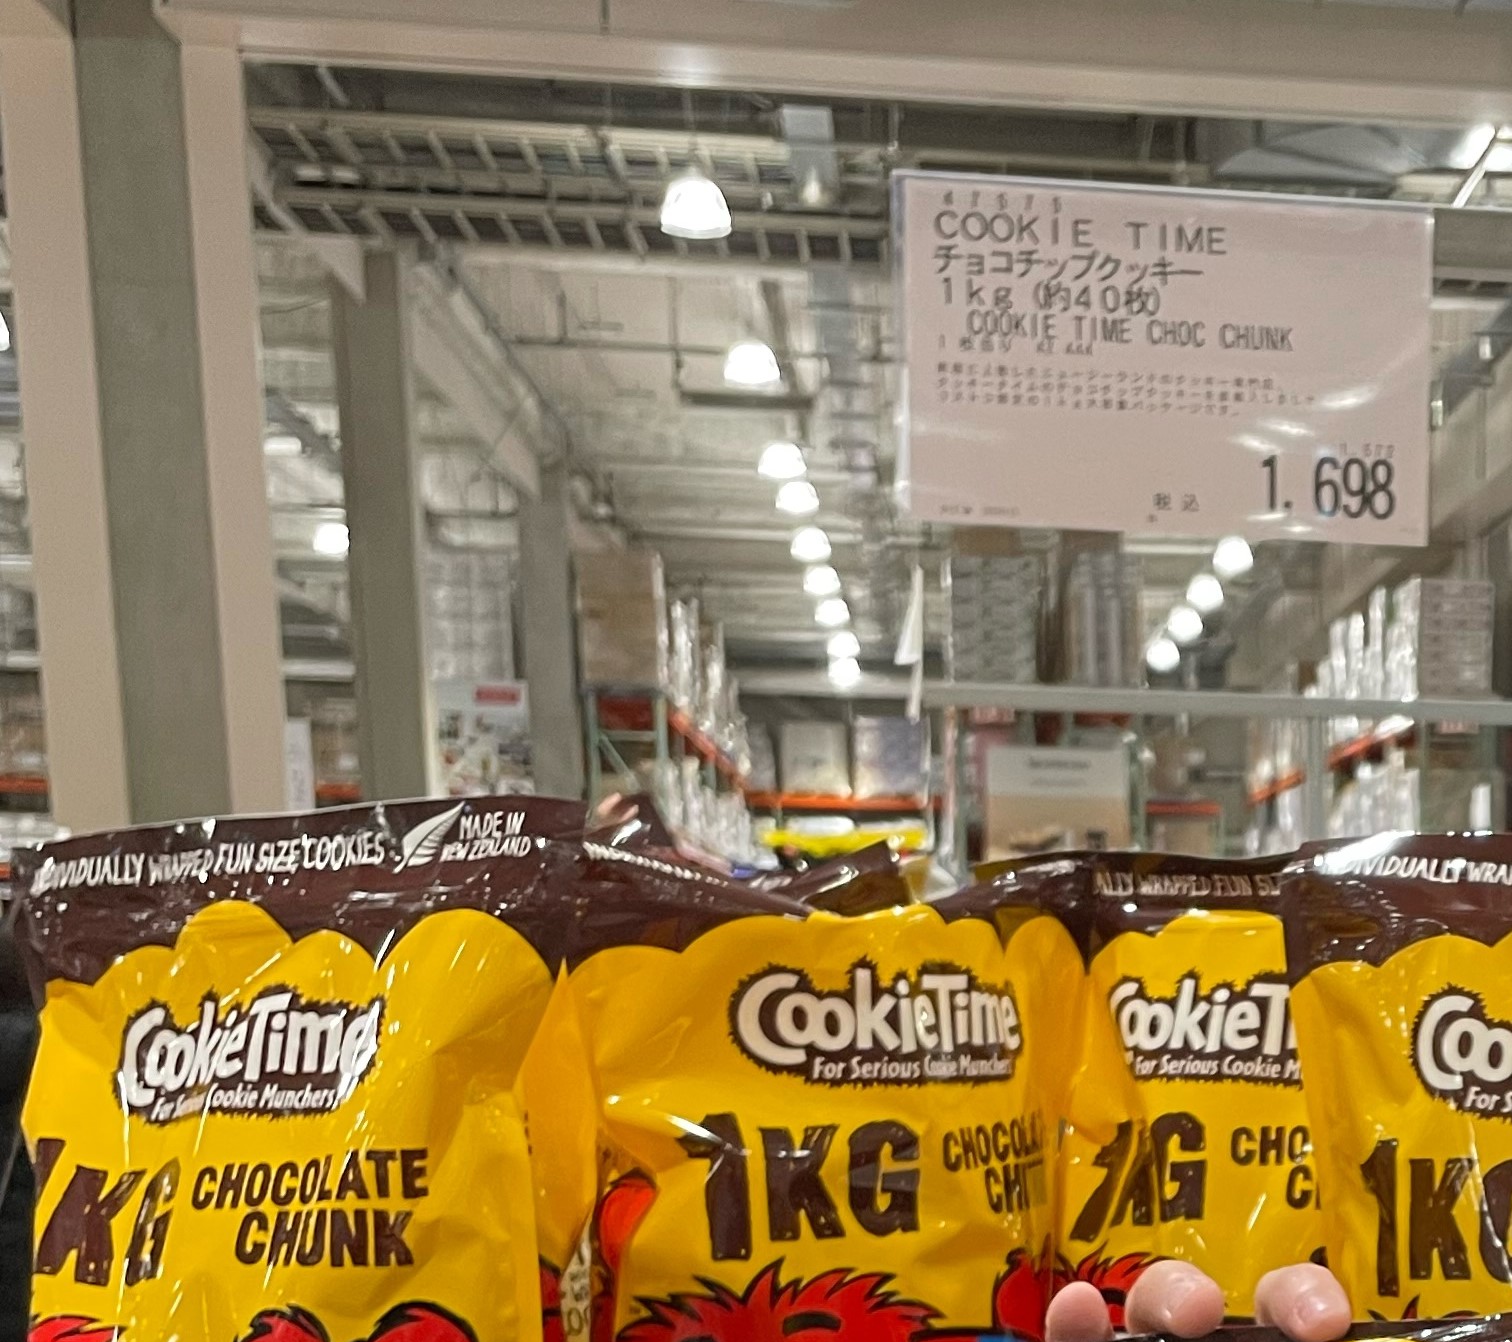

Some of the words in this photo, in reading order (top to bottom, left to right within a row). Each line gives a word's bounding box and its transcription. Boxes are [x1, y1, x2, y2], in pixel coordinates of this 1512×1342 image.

[933, 210, 1094, 248] COOKIE
[1125, 221, 1228, 255] TIME
[966, 308, 1058, 341] COOKIE
[1073, 315, 1133, 345] TIME
[1146, 320, 1206, 348] CHOC
[1218, 323, 1294, 352] CHUNK
[459, 812, 504, 840] MADE
[505, 811, 526, 834] IN
[213, 842, 256, 875] FUN
[255, 839, 300, 874] SIZE
[737, 967, 1021, 1065] CookieTime
[119, 992, 379, 1108] CookieTime
[812, 1056, 845, 1080] For
[851, 1056, 921, 1080] Serious
[1158, 1053, 1219, 1076] Serious
[1222, 1054, 1281, 1078] Cookie
[1463, 1086, 1501, 1113] For
[190, 1148, 429, 1211] CHOCOLATE
[675, 1111, 921, 1262] 1KG
[235, 1208, 414, 1269] CHUNK
